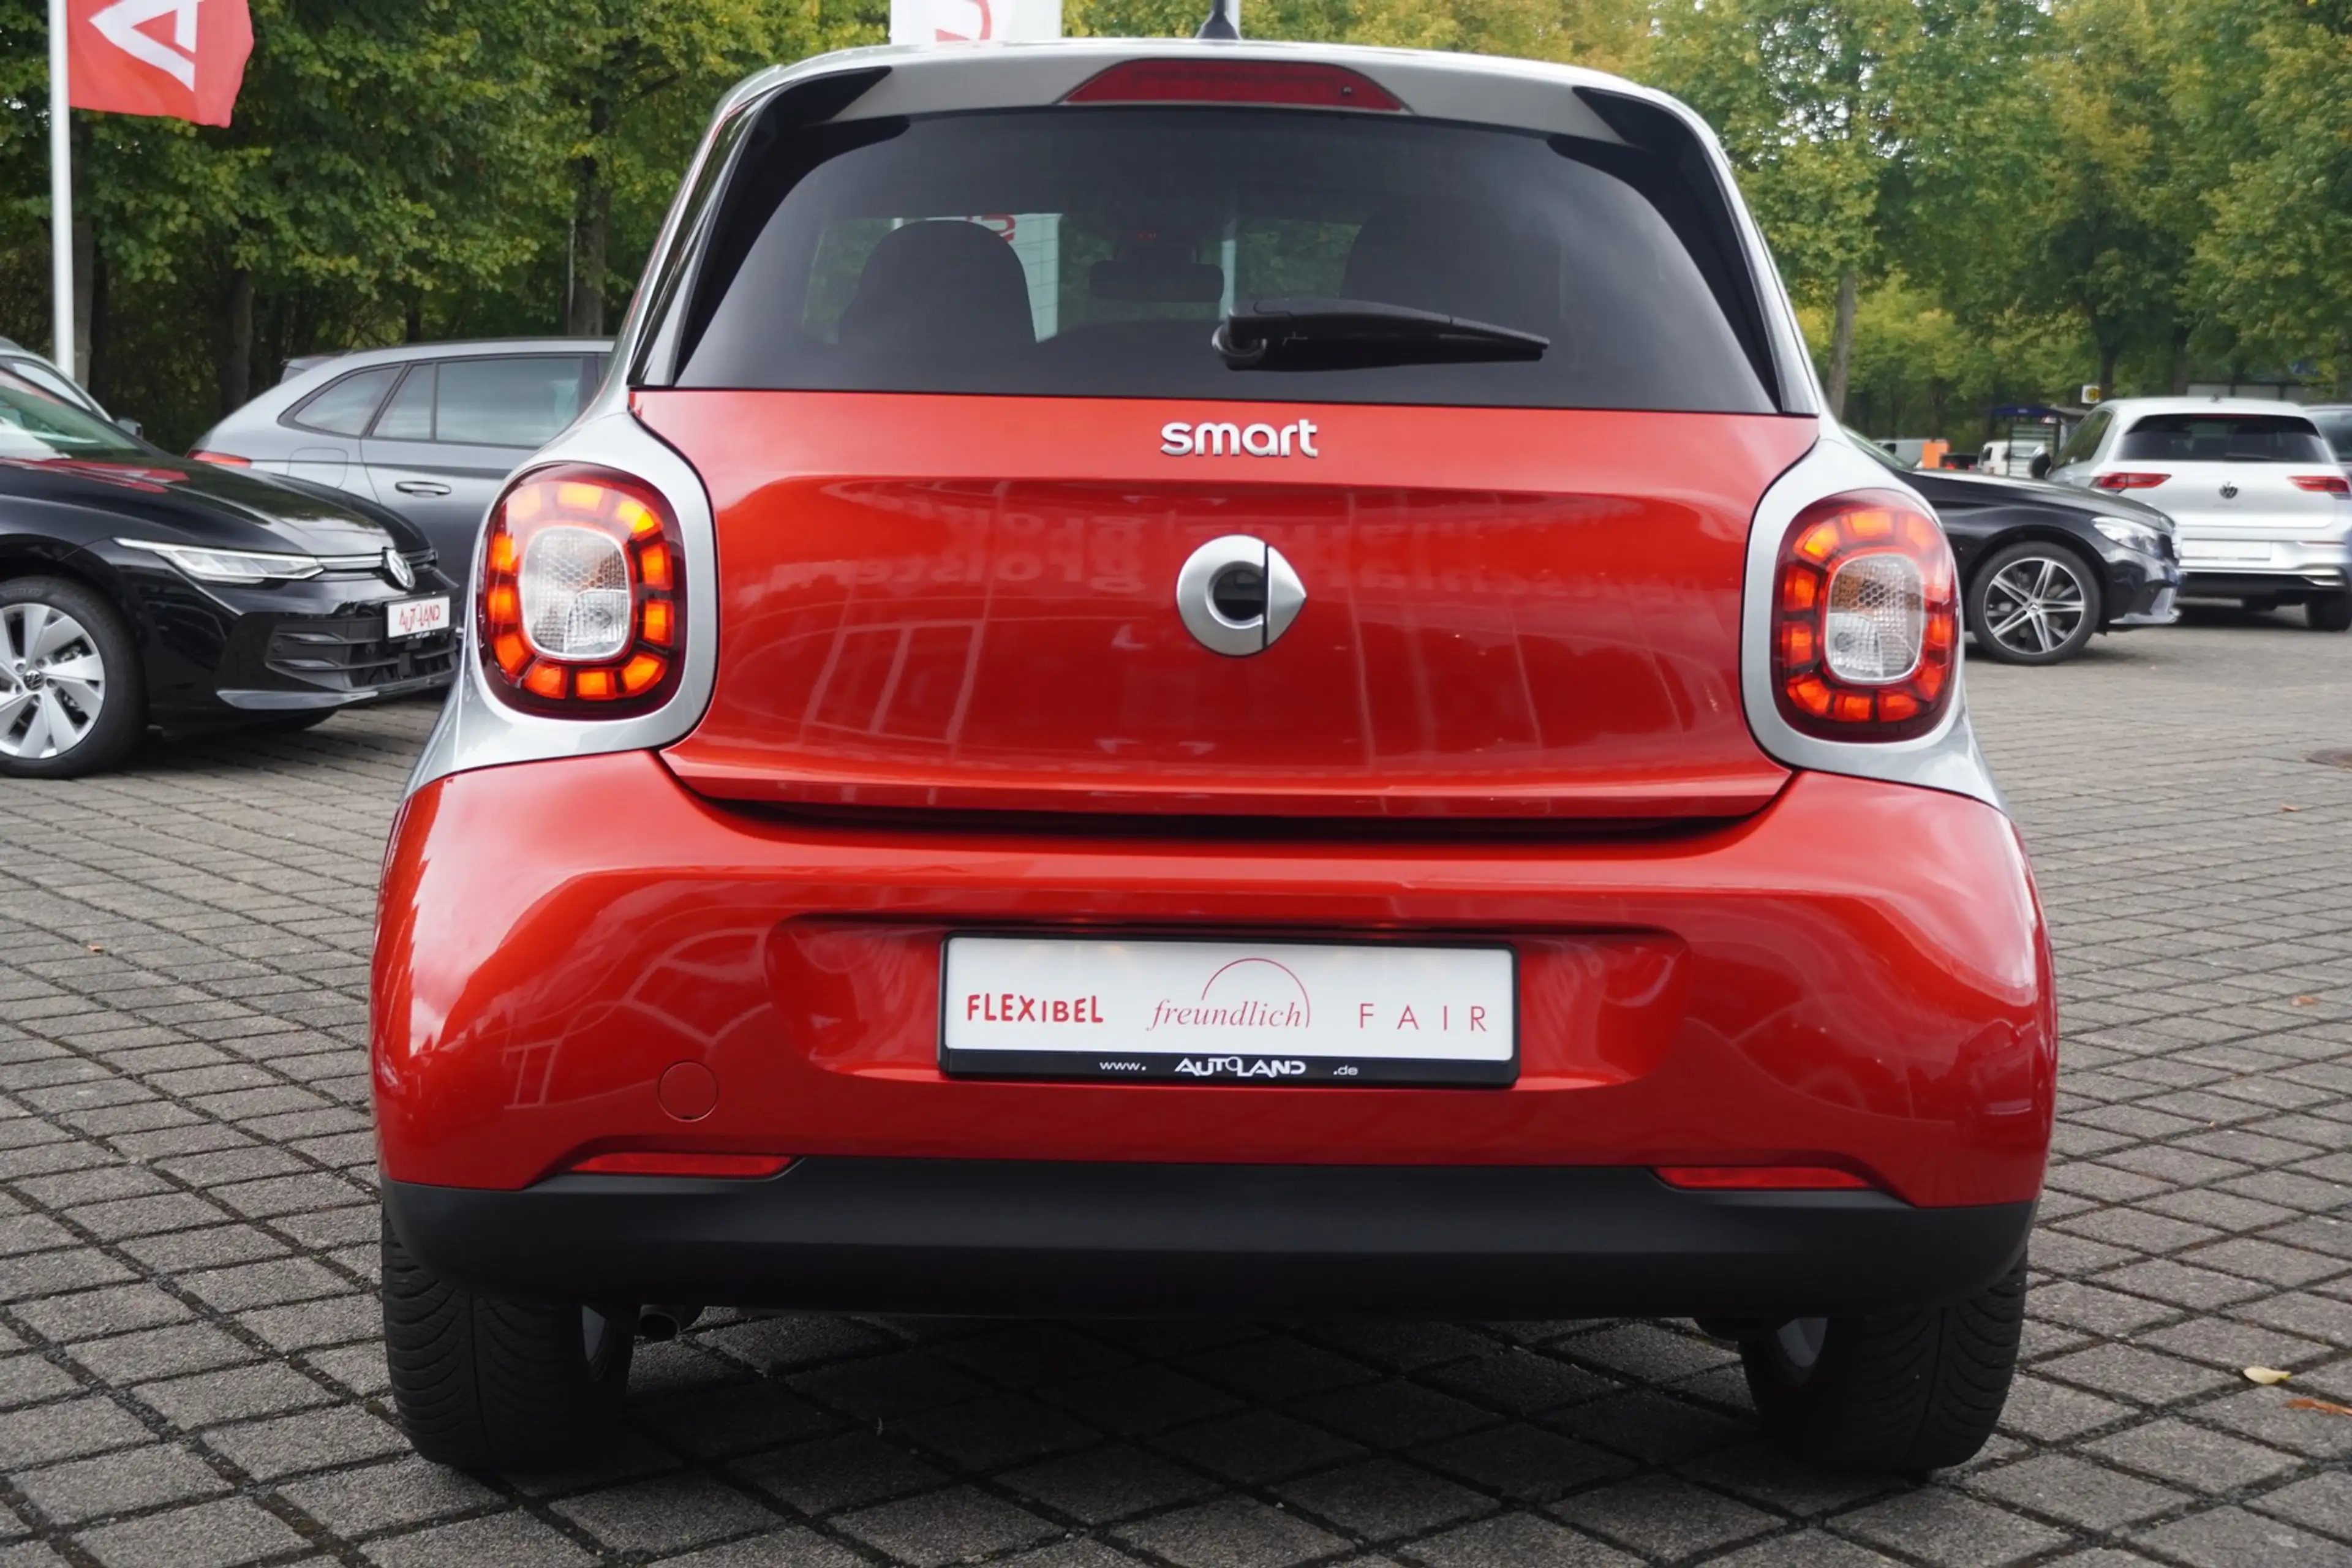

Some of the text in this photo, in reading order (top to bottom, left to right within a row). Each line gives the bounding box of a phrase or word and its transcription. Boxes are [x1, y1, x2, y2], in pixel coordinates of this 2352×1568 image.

[1160, 419, 1319, 459] smart
[967, 993, 1487, 1032] FLEXIBEL freundlich FAIR
[1099, 1056, 1359, 1078] www. AUTOLAND .de
